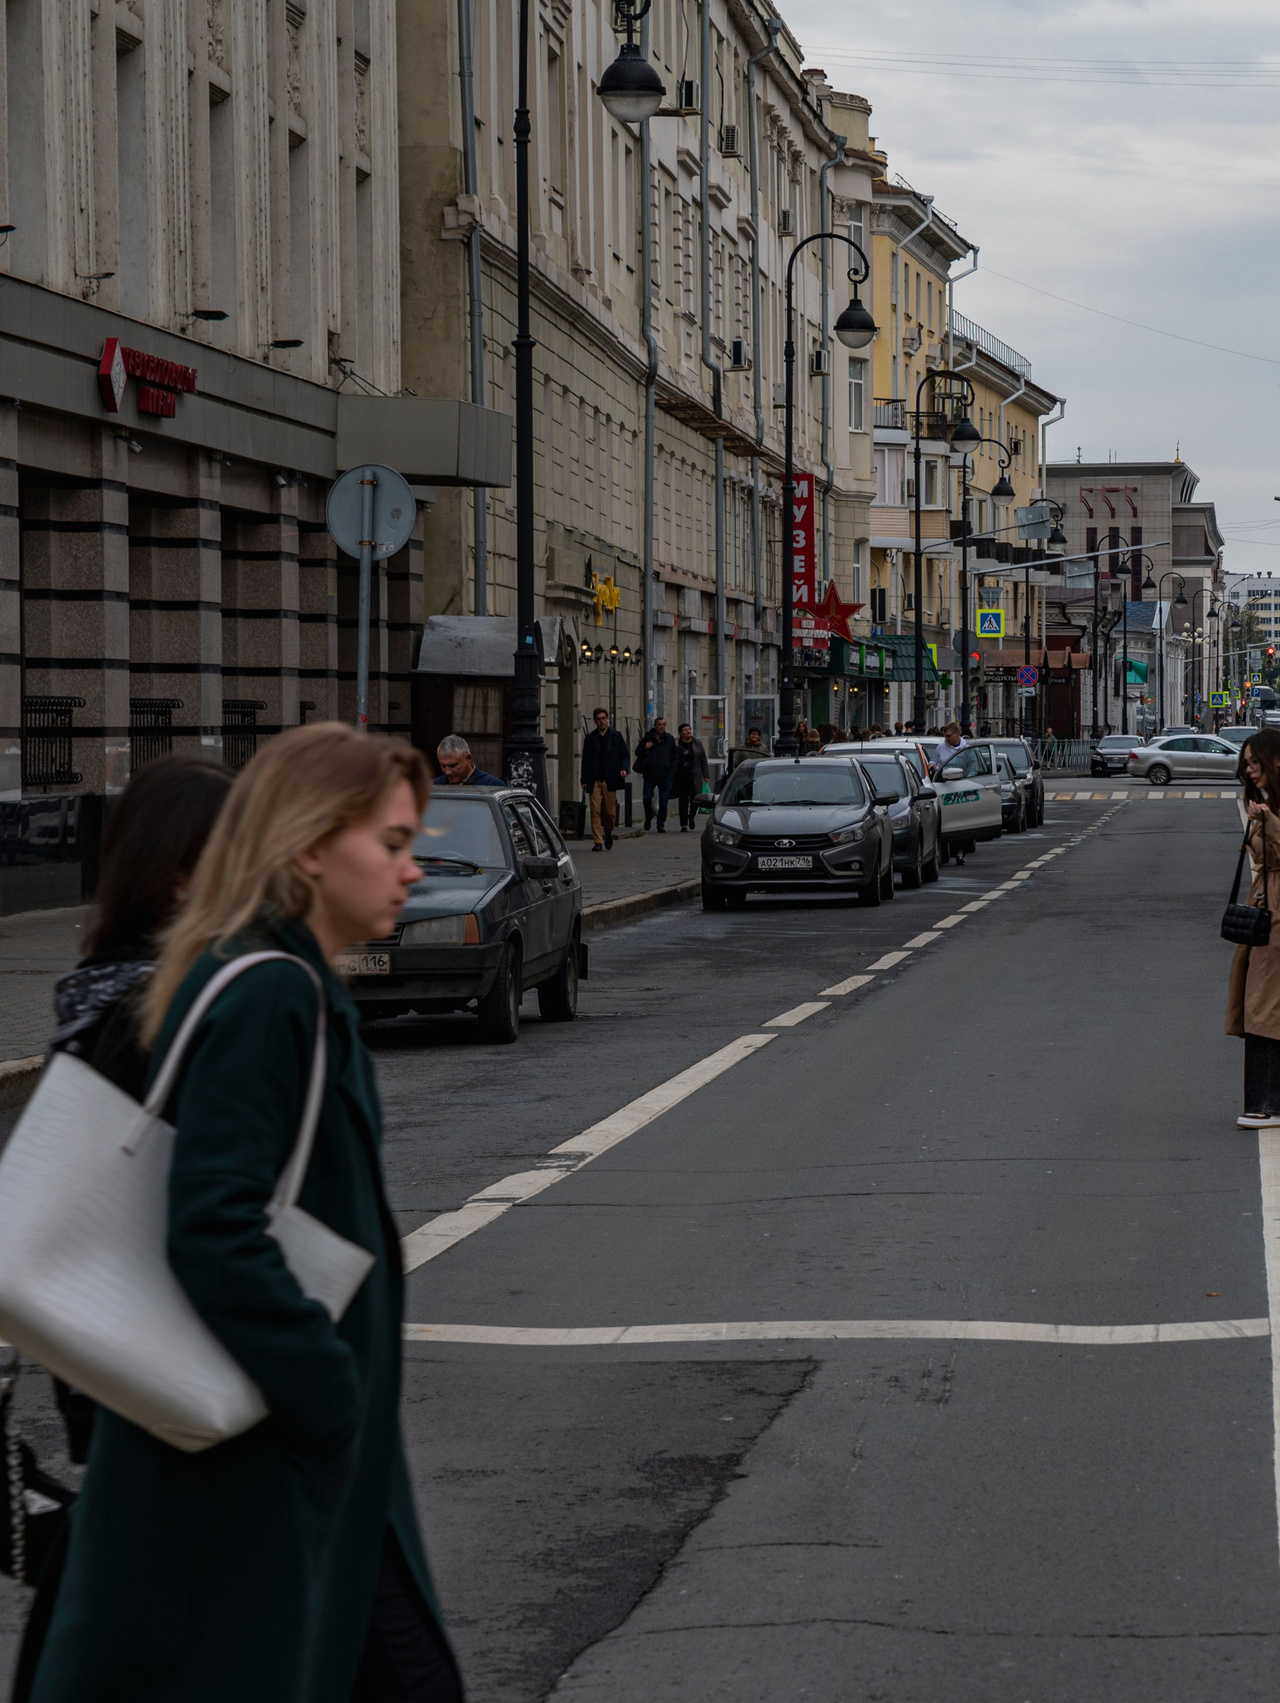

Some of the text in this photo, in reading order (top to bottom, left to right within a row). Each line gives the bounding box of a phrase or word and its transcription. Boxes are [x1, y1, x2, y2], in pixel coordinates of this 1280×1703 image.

[793, 480, 809, 603] МУЗЕЙ
[761, 859, 795, 867] А021НК
[362, 955, 385, 967] 116
